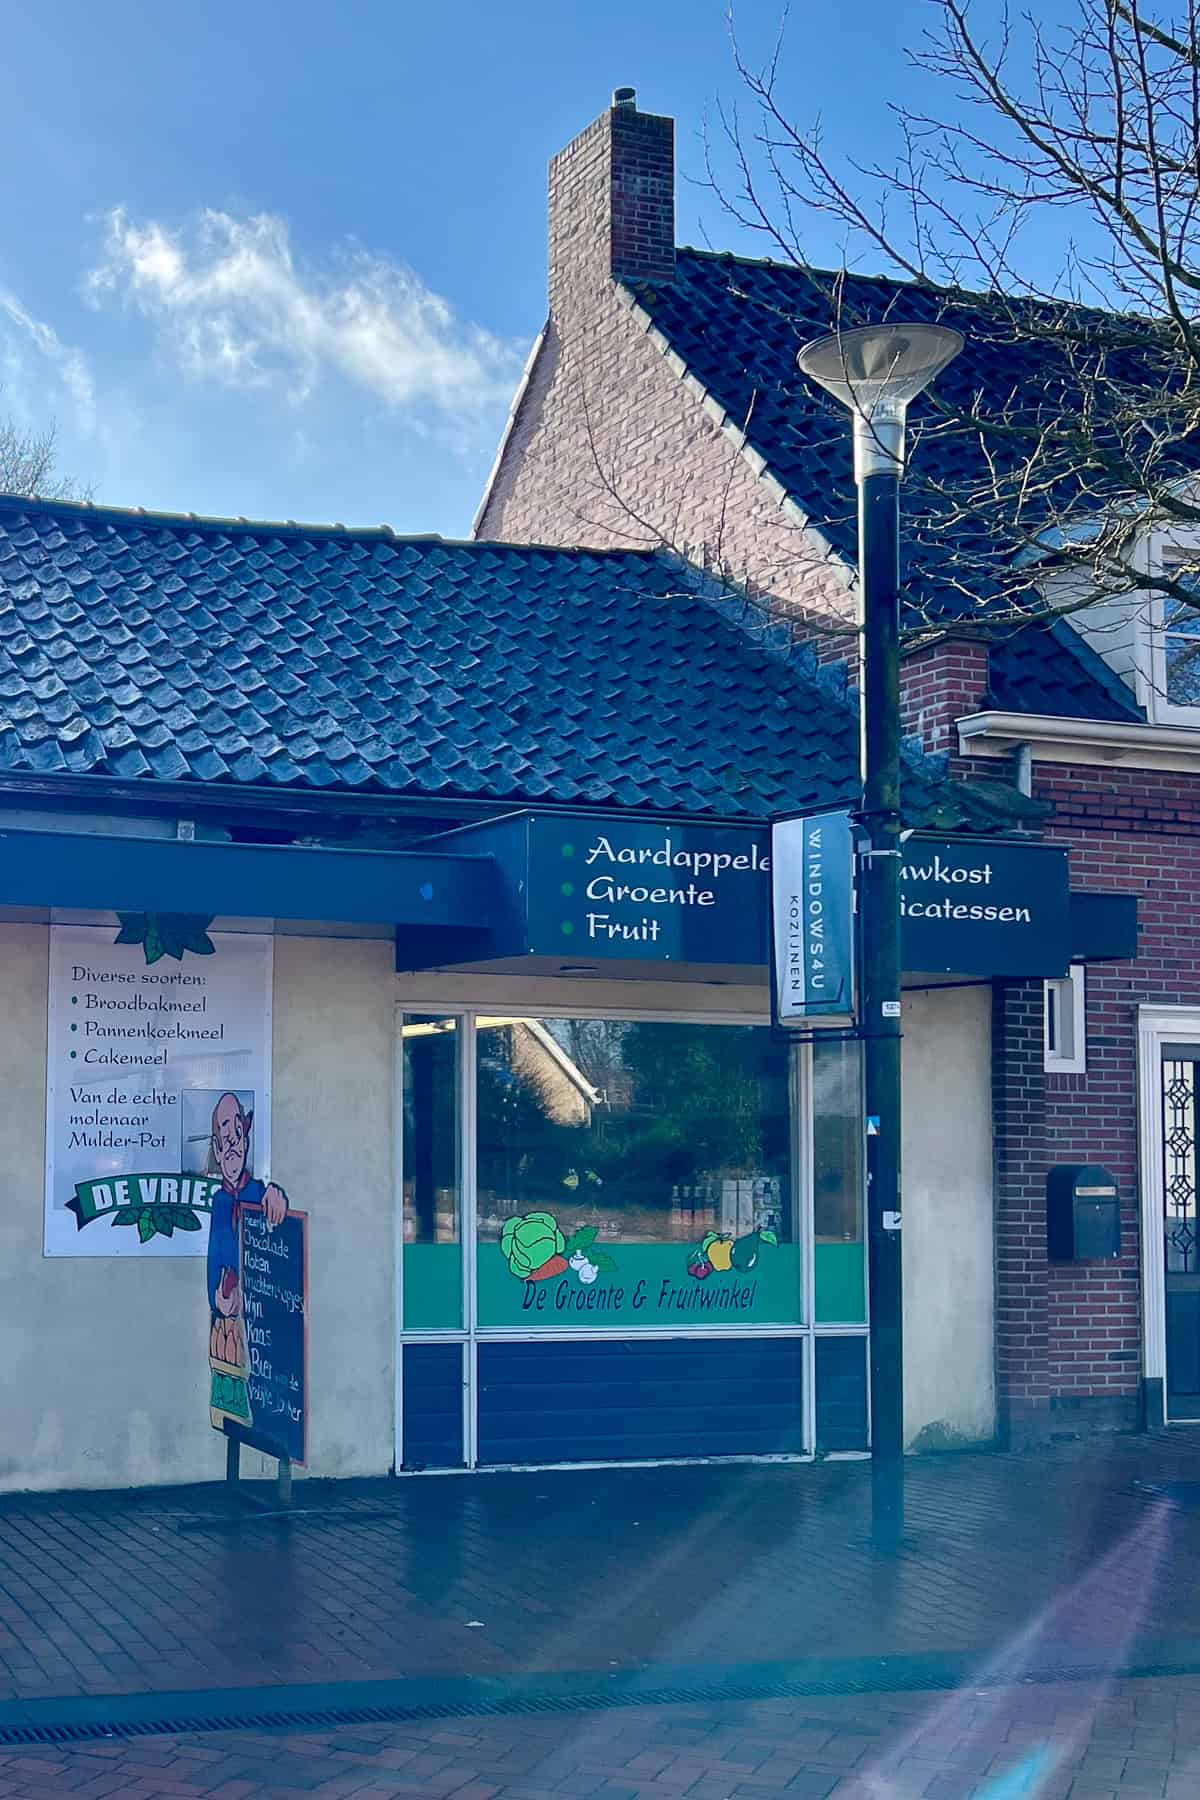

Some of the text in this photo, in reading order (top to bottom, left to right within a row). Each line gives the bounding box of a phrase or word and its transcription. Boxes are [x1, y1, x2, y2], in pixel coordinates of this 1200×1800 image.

[584, 836, 770, 878] Aardappele
[585, 876, 716, 906] Groente
[809, 828, 825, 990] WINDOWS4U
[900, 894, 1032, 923] icatessen
[586, 912, 661, 942] Fruit
[789, 895, 801, 991] KOZIJNEN
[71, 965, 207, 986] Diverse soorten:
[84, 993, 207, 1013] Broodbakmeel
[84, 1020, 224, 1040] Pannenkoekmeel
[83, 1048, 168, 1065] Cakemeel
[70, 1087, 177, 1106] Van de echte
[70, 1108, 149, 1126] molenaar
[68, 1131, 167, 1149] Mulder-Pot
[91, 1180, 131, 1211] DE
[521, 1279, 758, 1311] De Groente & Fruitwinkel
